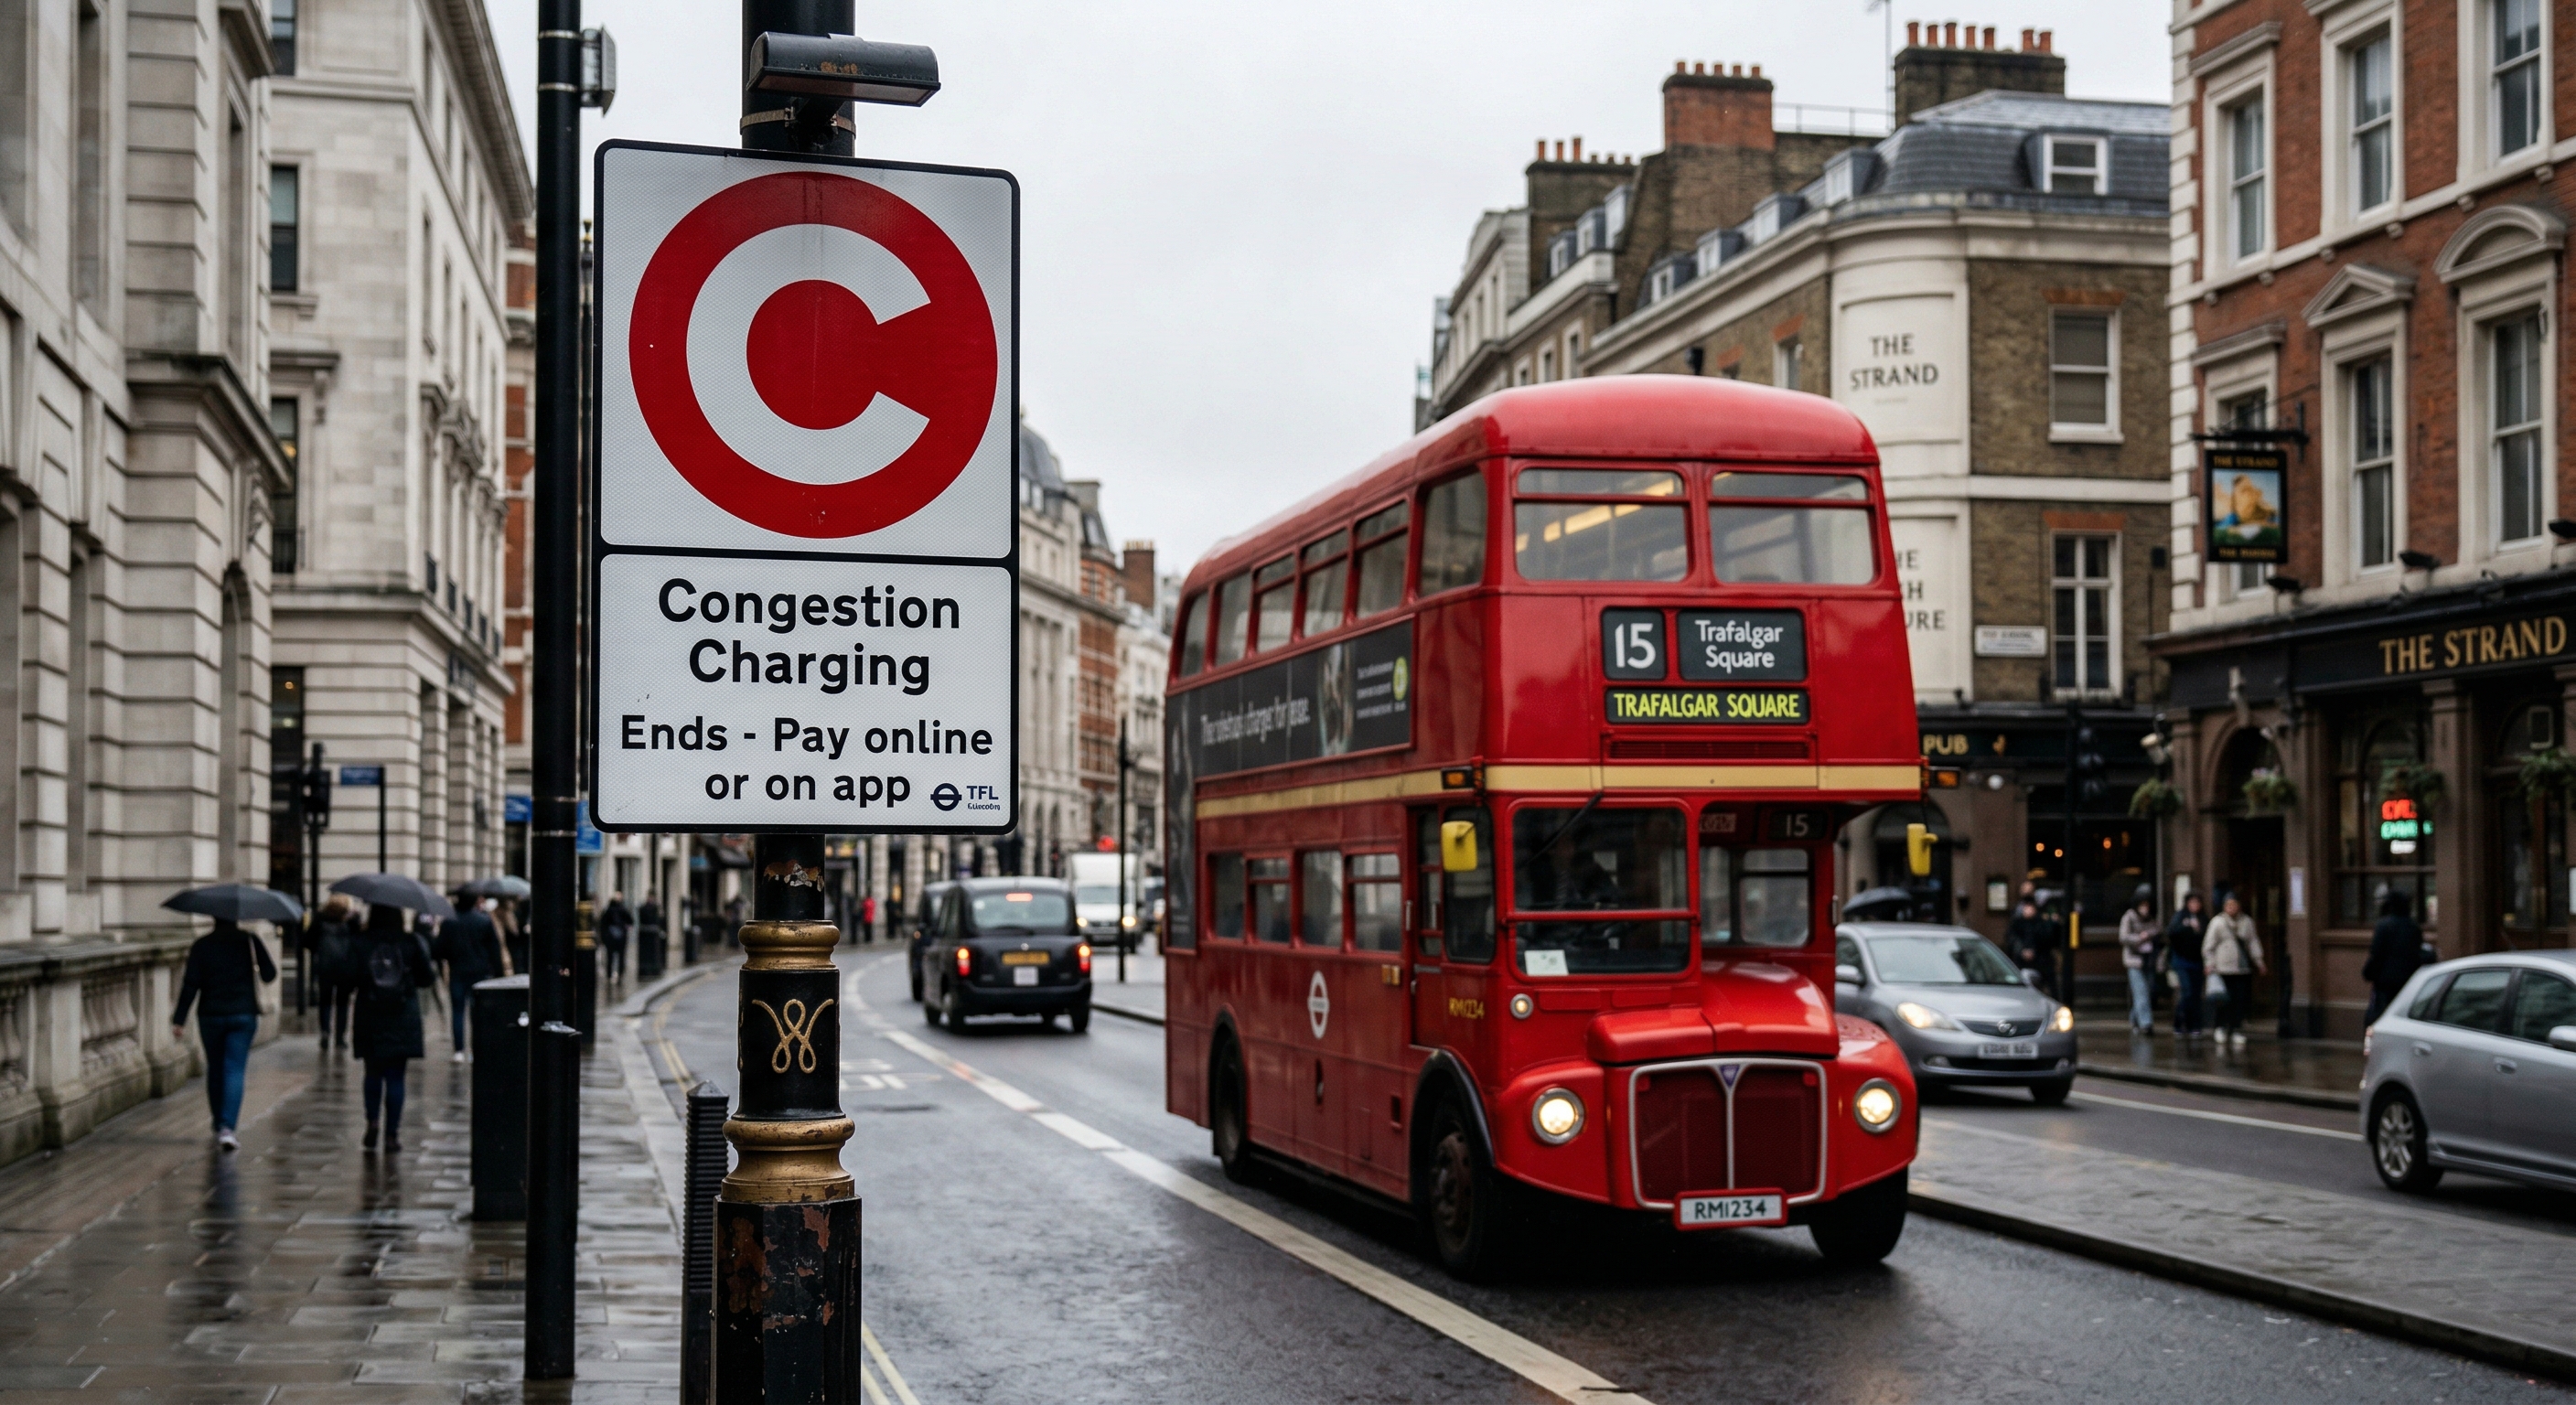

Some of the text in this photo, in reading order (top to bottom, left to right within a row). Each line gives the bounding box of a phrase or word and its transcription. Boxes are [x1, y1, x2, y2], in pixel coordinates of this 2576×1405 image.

[686, 223, 931, 485] C
[1870, 333, 1914, 357] THE
[1851, 363, 1939, 391] STRAND
[659, 578, 960, 634] Congestion
[1615, 623, 1656, 669] 15
[1695, 620, 1784, 649] Trafalgar
[2379, 616, 2567, 674] THE STRAND
[690, 638, 929, 695] Charging
[1706, 645, 1775, 674] Square
[1614, 693, 1801, 718] TRAFALGAR SQUARE
[622, 714, 727, 751] Ends
[774, 717, 850, 759] Pay
[864, 720, 993, 755] online
[1923, 734, 1969, 756] PUB
[705, 774, 910, 808] or on app
[967, 786, 999, 800] TFL
[1786, 814, 1809, 837] 15
[1694, 1199, 1766, 1219] RM1234
